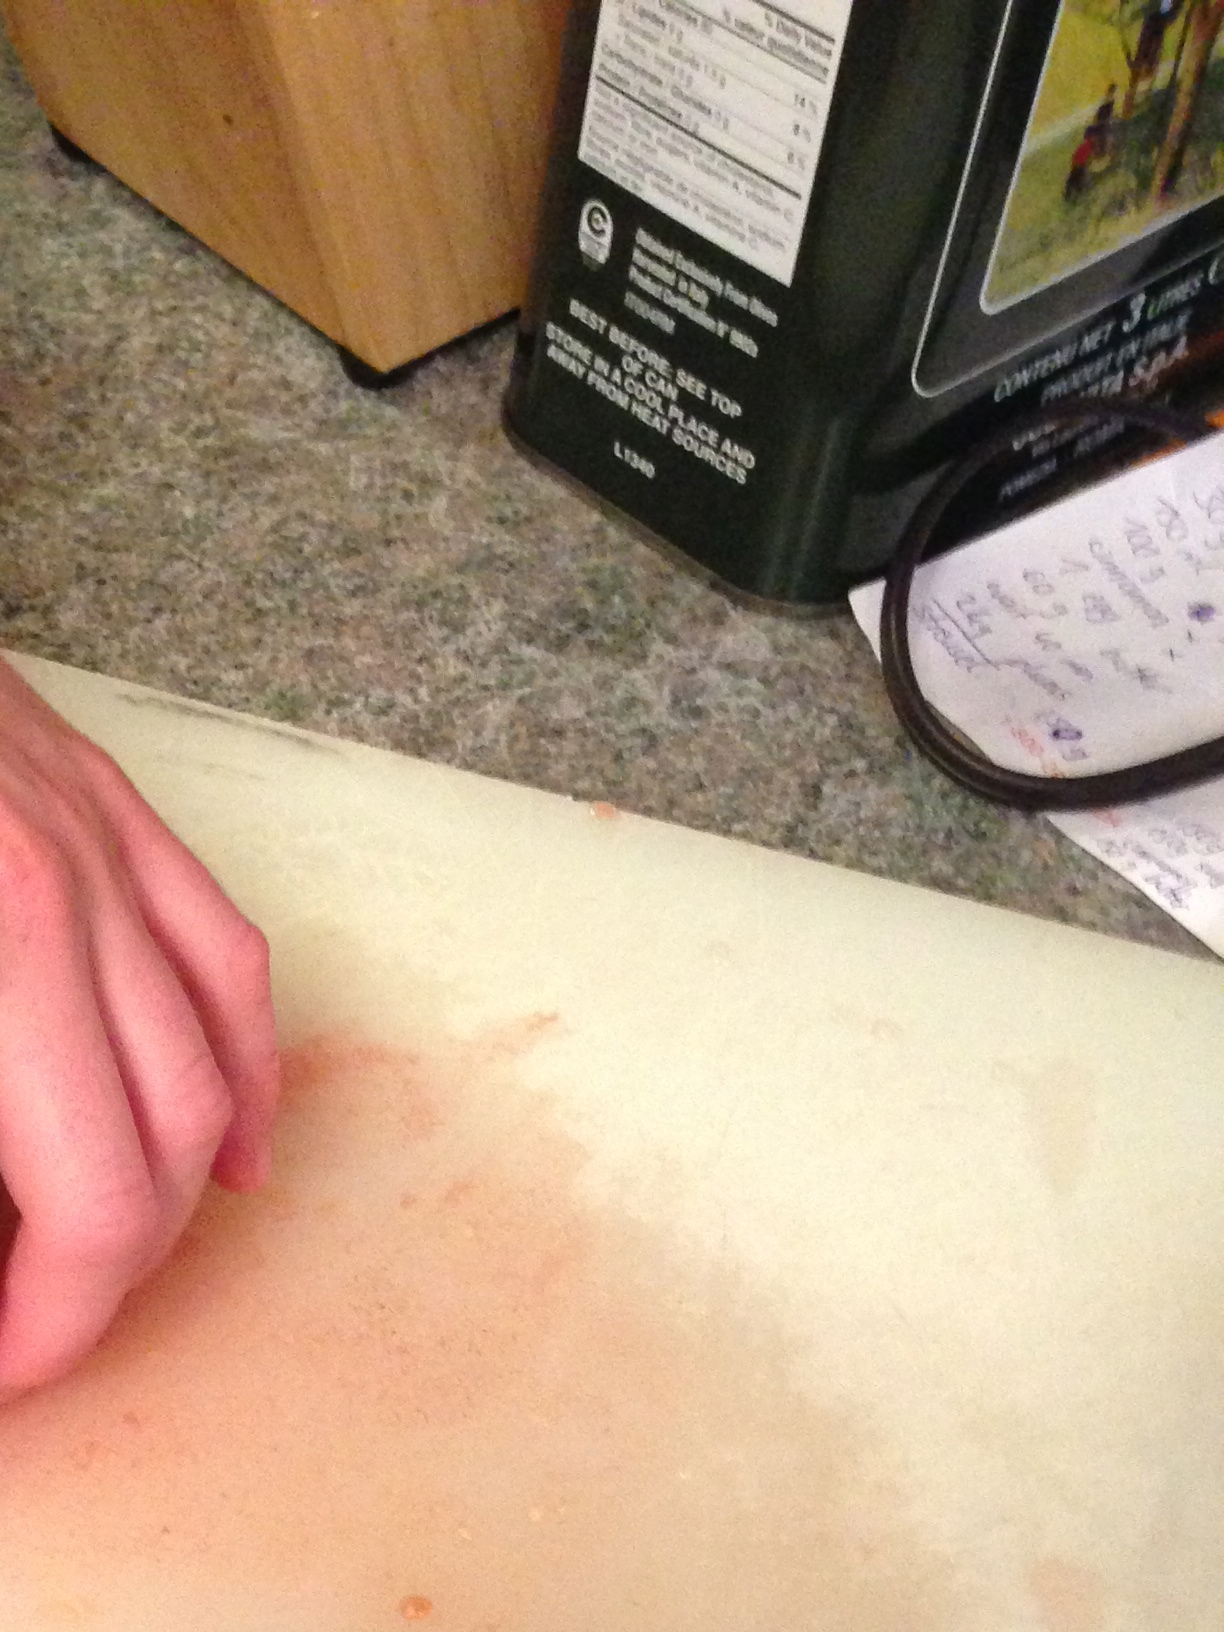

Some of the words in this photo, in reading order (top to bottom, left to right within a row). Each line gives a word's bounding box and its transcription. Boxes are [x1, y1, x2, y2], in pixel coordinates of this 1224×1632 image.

[545, 320, 593, 366] STORE
[594, 355, 611, 377] IN
[610, 367, 622, 386] A
[624, 375, 666, 415] COOL
[668, 403, 720, 448] PLACE
[721, 437, 756, 469] AND
[546, 344, 587, 380] AWAY
[587, 369, 630, 410] FROM
[630, 400, 672, 435] HEAT
[672, 427, 748, 485] SOURCES
[569, 298, 608, 334] BEST
[676, 368, 708, 400] SEE
[710, 387, 743, 418] TOP
[621, 354, 645, 377] OF
[645, 369, 679, 400] CAN
